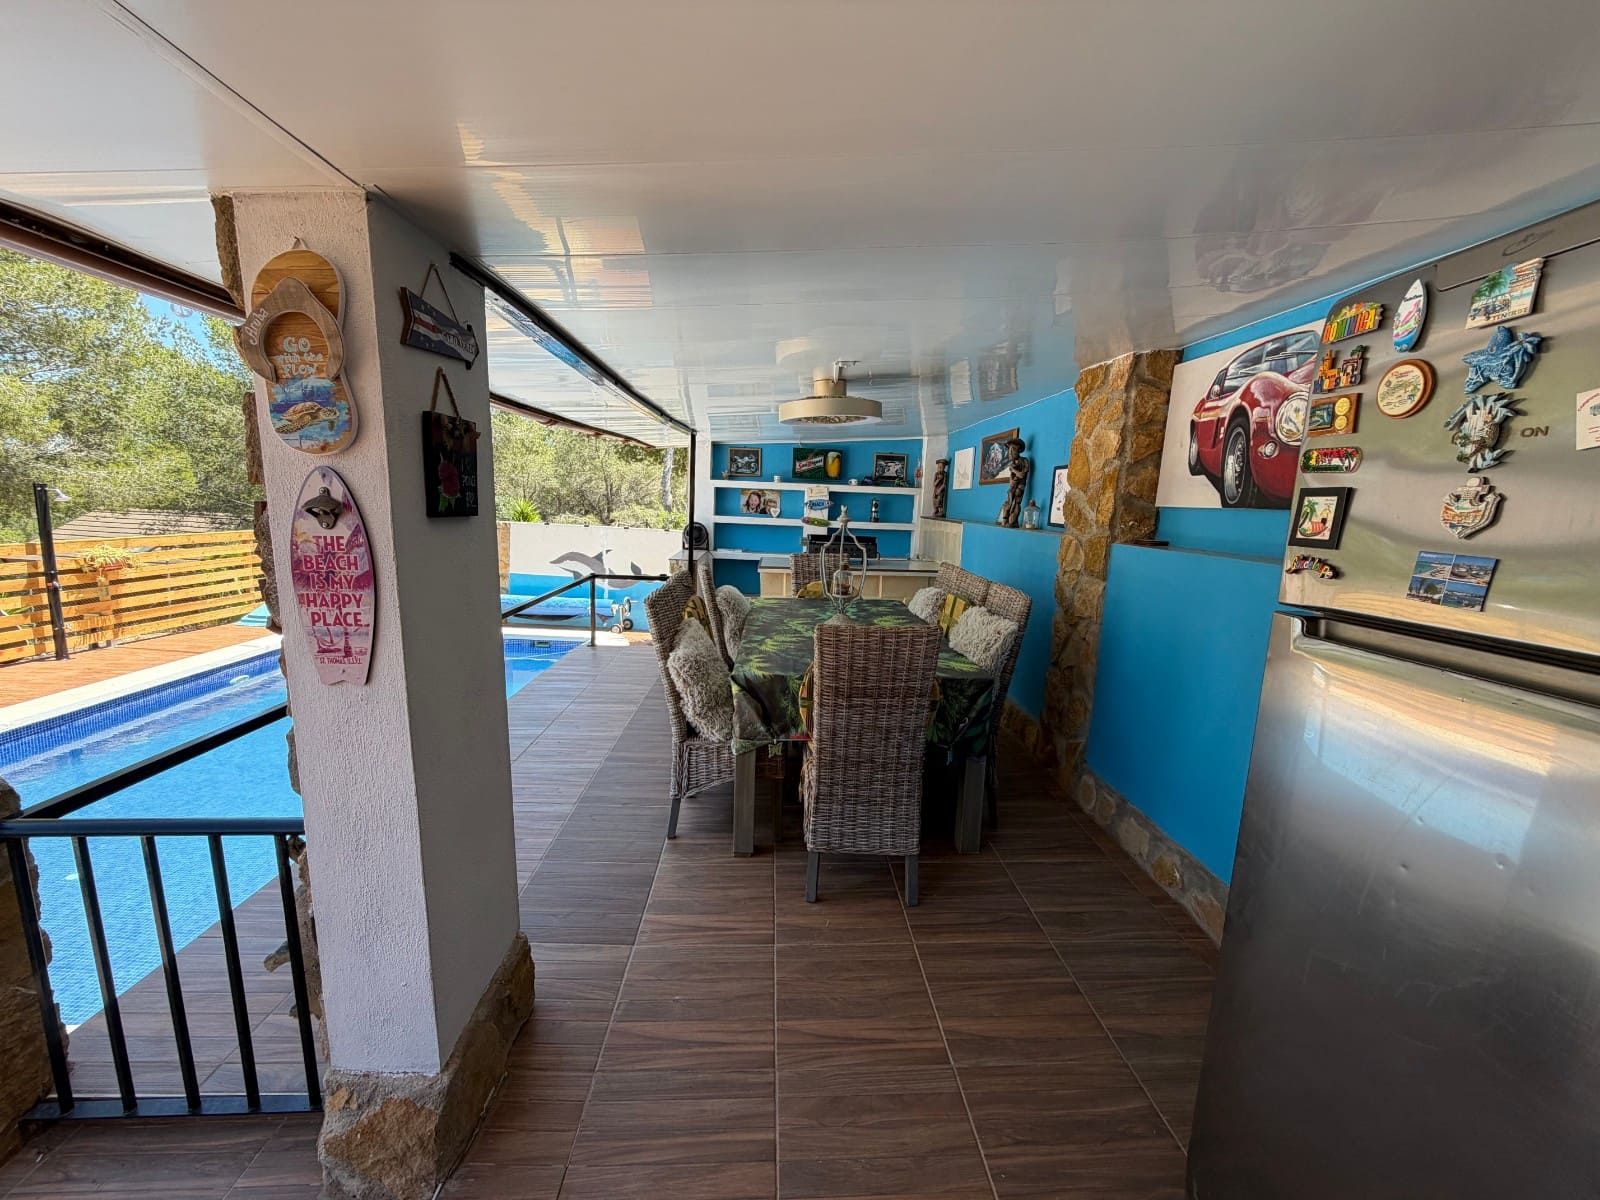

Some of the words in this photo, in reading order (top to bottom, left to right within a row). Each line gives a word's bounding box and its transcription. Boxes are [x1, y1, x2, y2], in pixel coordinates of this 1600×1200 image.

[245, 308, 269, 345] Aruba
[1520, 425, 1550, 438] ON
[312, 535, 346, 552] THE
[303, 554, 359, 571] BEACH
[310, 573, 327, 590] IS
[330, 573, 354, 590] MY
[305, 592, 363, 609] HAPPY
